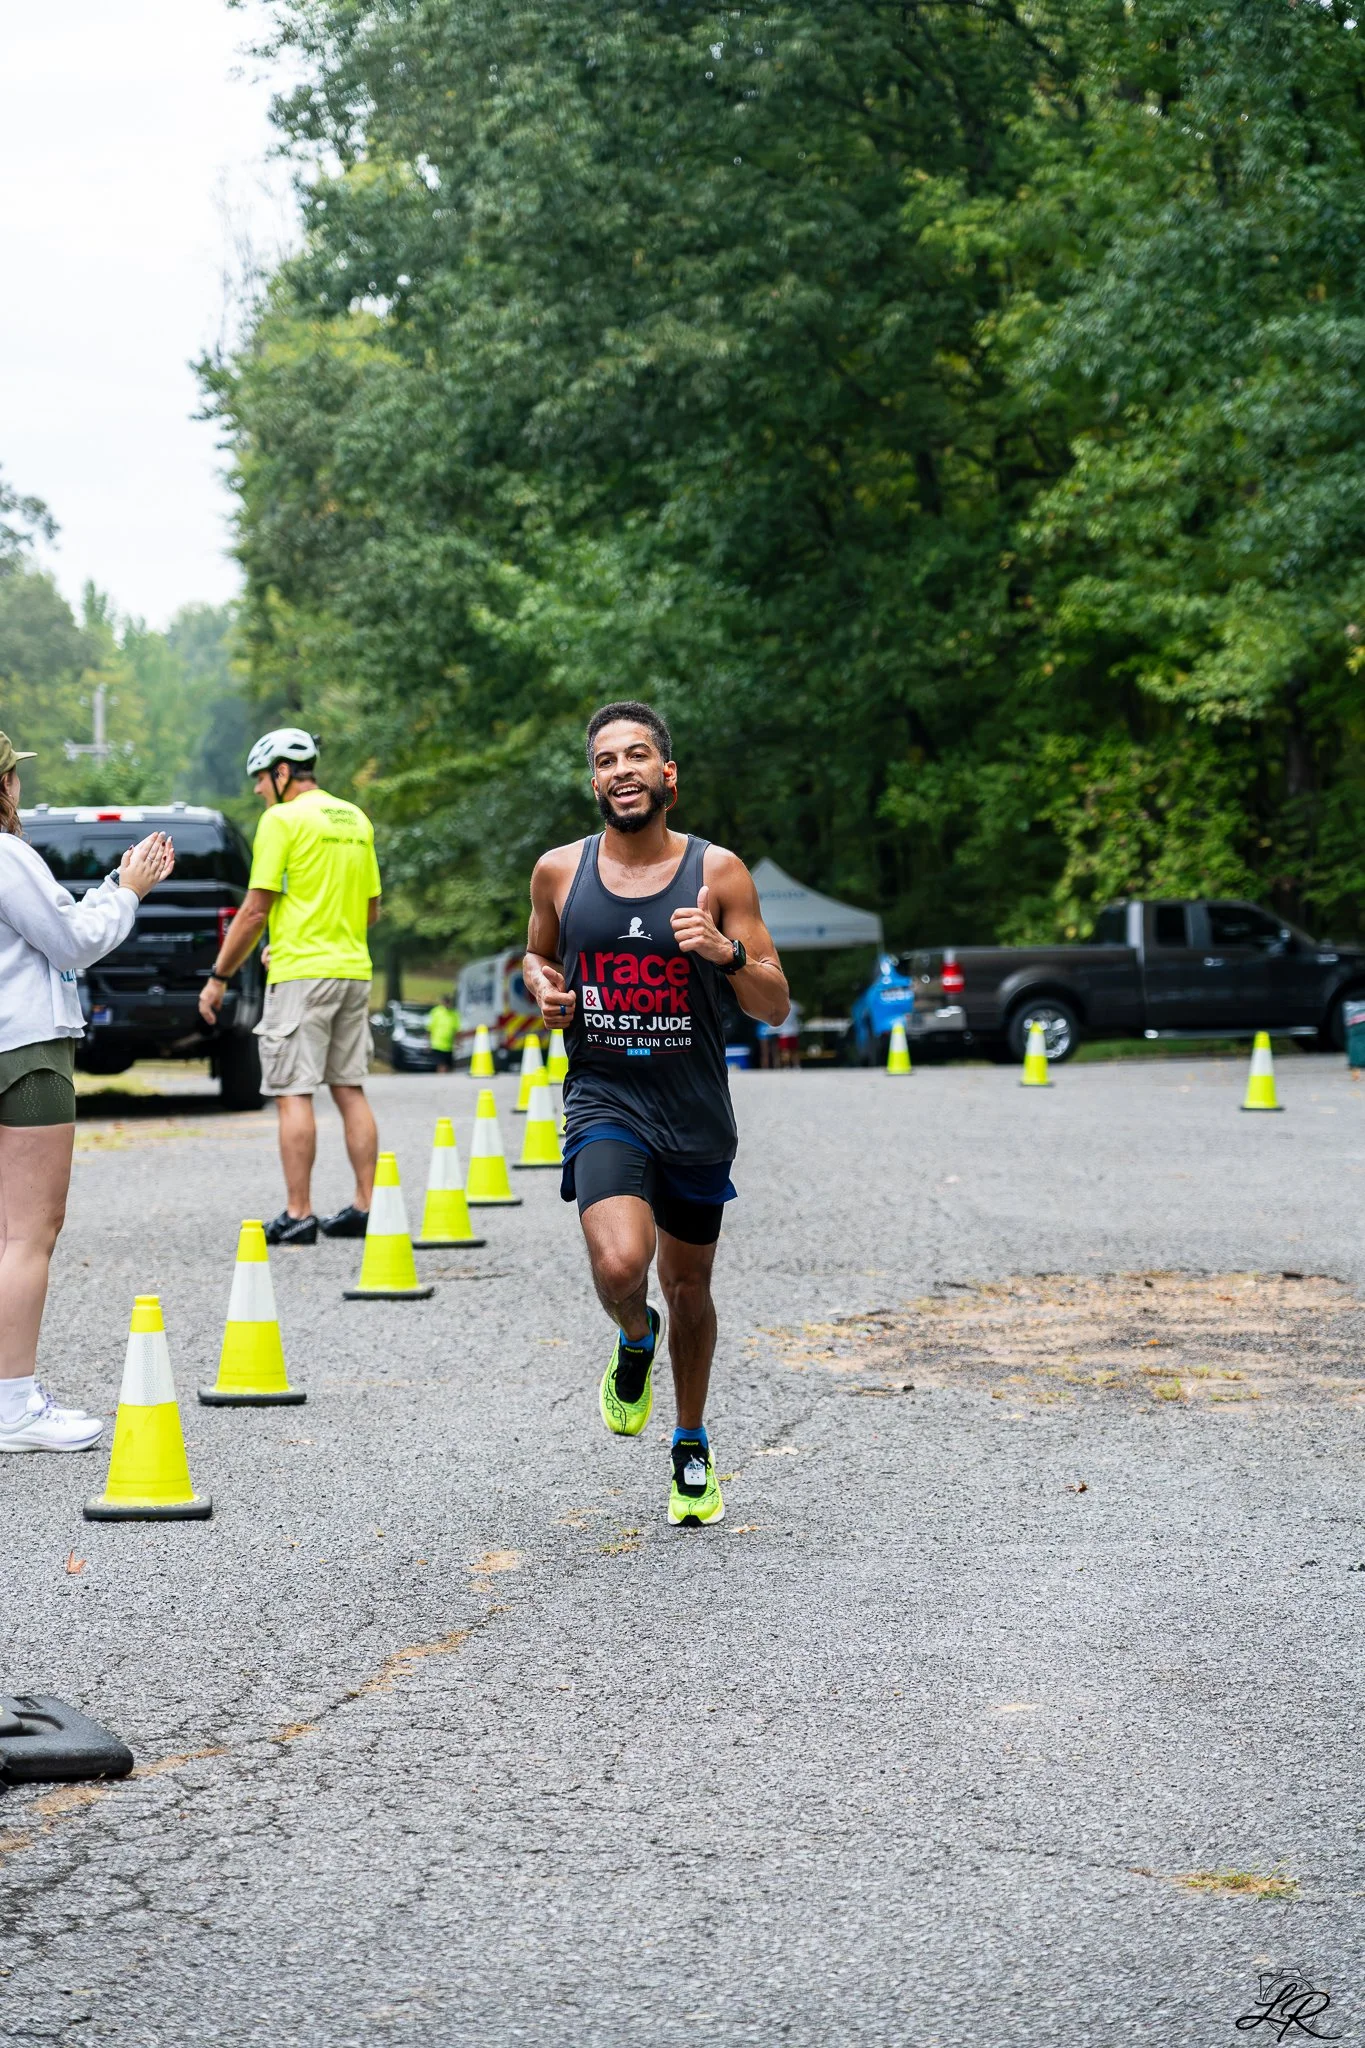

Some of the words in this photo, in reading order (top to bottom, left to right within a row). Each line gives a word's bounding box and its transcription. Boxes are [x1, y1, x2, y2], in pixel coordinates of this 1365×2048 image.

[579, 951, 589, 983] I
[594, 951, 691, 987] race
[585, 989, 597, 1007] &
[601, 985, 690, 1014] work
[583, 1012, 616, 1030] FOR
[618, 1014, 644, 1031] ST.
[646, 1015, 692, 1032] JUDE
[587, 1033, 602, 1043] ST.
[604, 1035, 633, 1047] JUDE
[637, 1037, 660, 1048] RUN
[664, 1037, 692, 1047] CLUB
